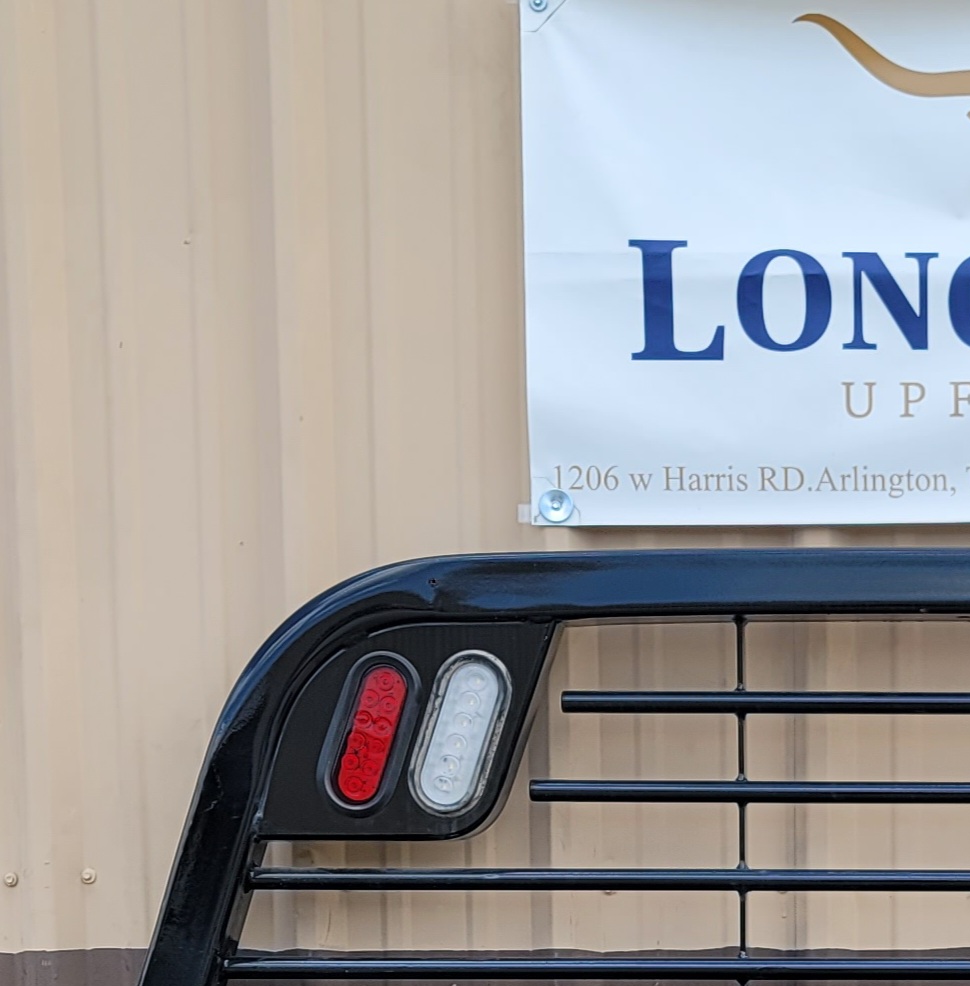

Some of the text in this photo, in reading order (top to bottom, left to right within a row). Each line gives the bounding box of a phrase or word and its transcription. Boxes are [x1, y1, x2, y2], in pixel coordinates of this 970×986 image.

[553, 464, 619, 491] 1206
[628, 472, 653, 492] w
[662, 465, 748, 492] Harris
